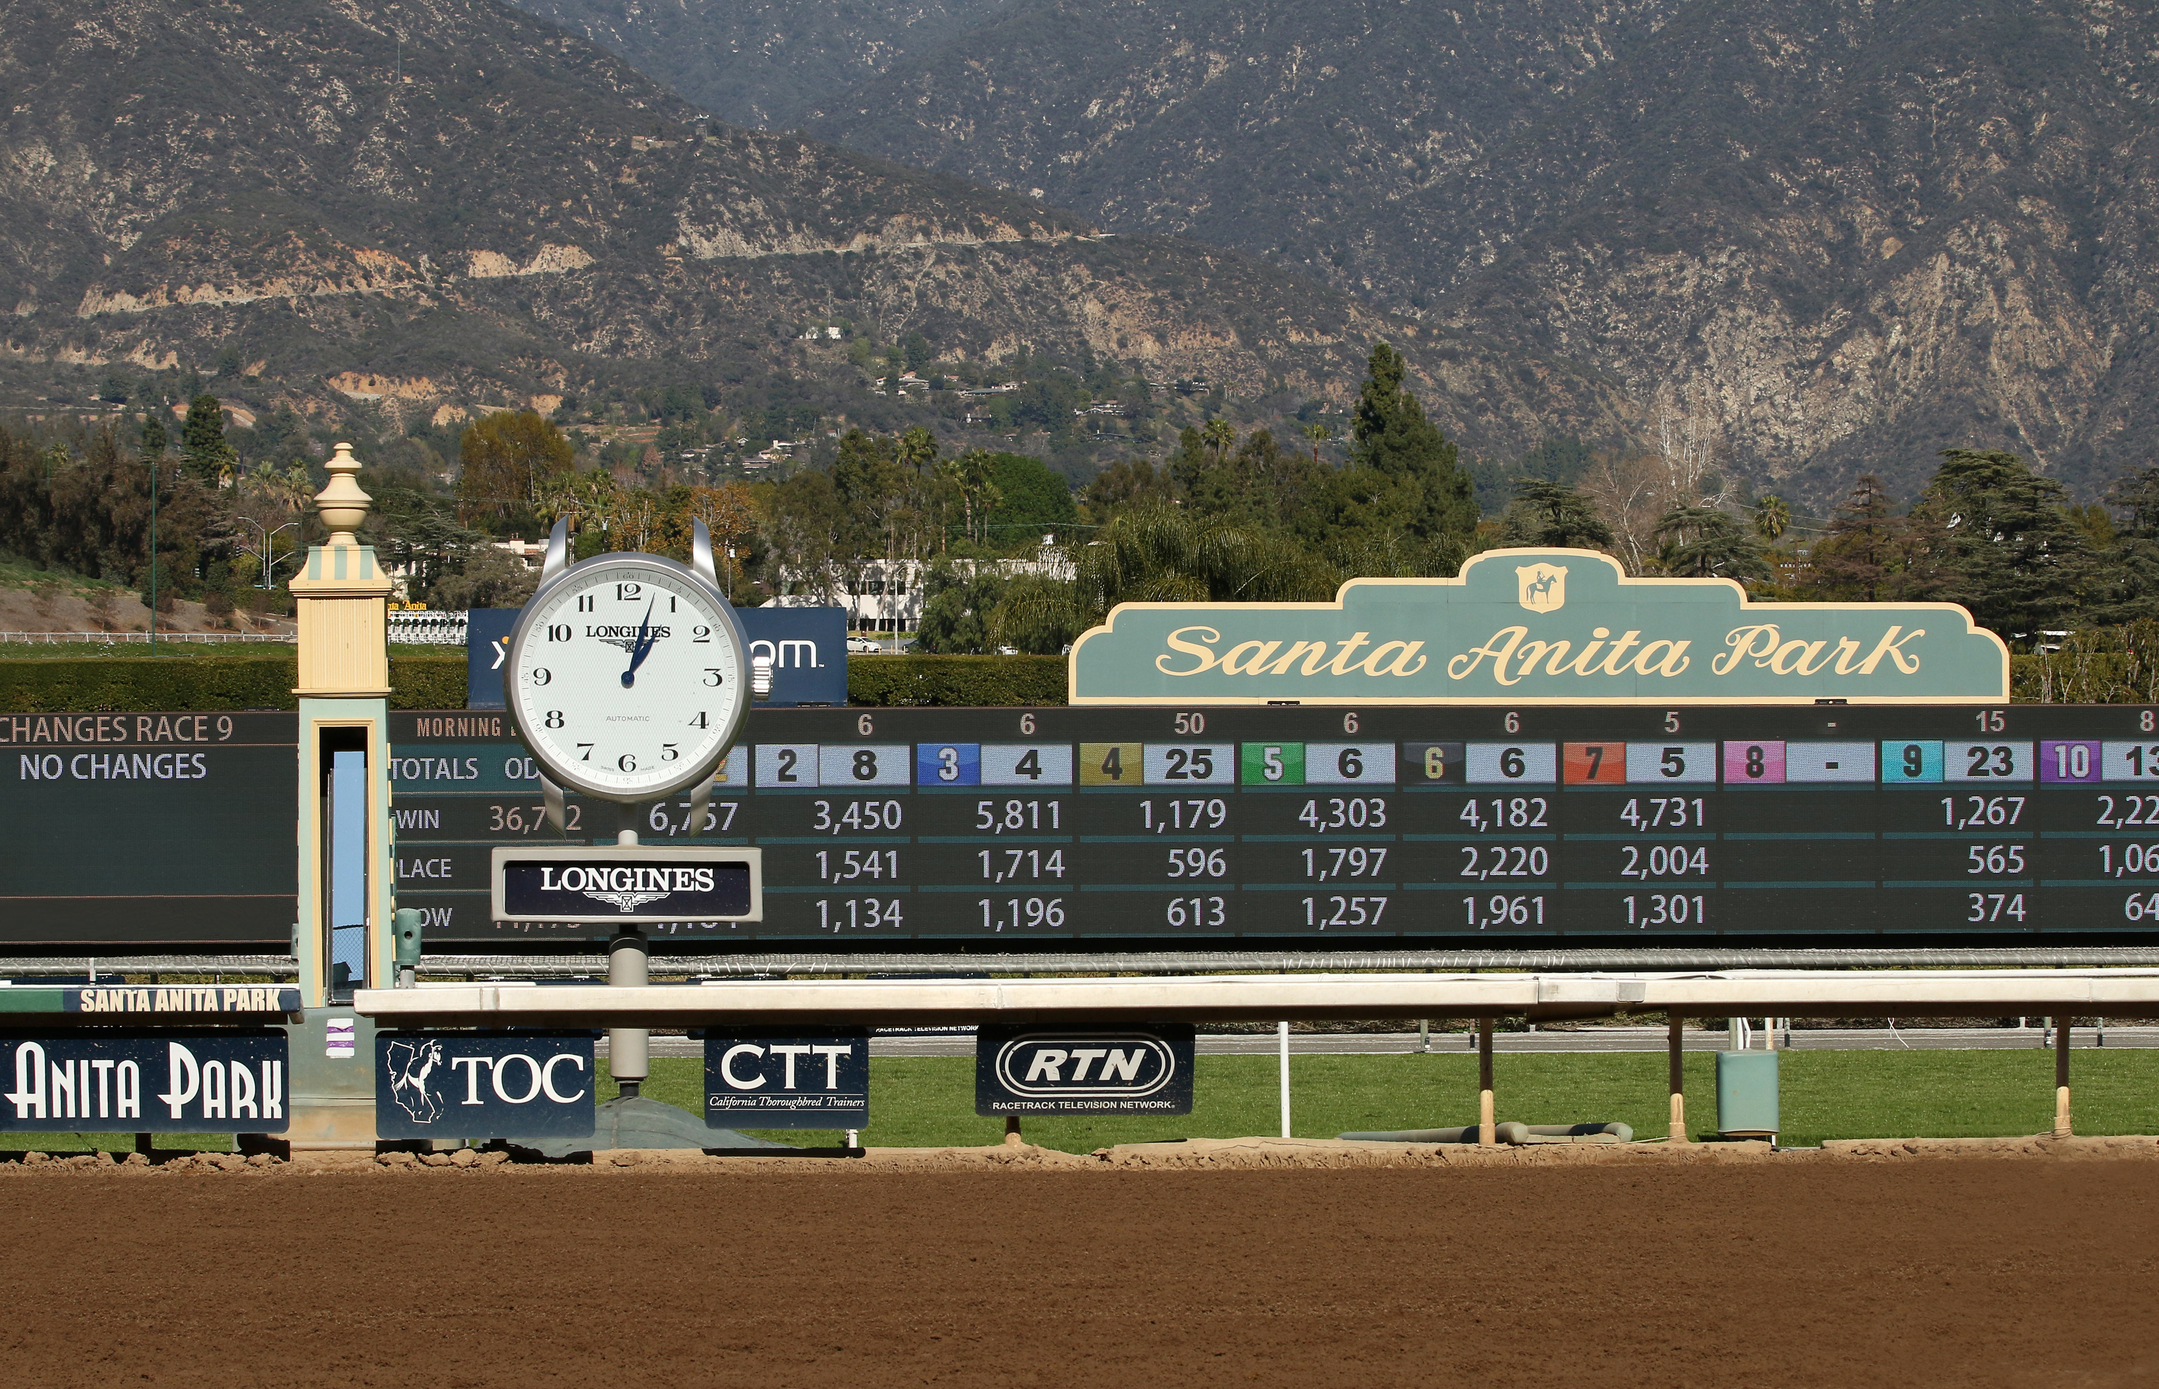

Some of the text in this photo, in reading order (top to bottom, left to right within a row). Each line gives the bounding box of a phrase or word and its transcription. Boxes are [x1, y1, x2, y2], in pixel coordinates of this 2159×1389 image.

[615, 582, 642, 601] 12
[577, 594, 594, 613] 11
[668, 595, 677, 613] 1
[547, 623, 572, 643] 10
[585, 625, 671, 638] LONGINES
[692, 624, 711, 643] 2
[1155, 623, 1926, 686] Santa Anita Park
[532, 667, 552, 686] 9
[702, 668, 723, 687] 3
[136, 715, 209, 741] RACE
[216, 715, 233, 741] 9
[416, 717, 501, 737] MORNING
[544, 709, 565, 729] 8
[687, 711, 710, 730] 4
[857, 713, 873, 736] 6
[1019, 712, 1036, 735] 6
[1174, 712, 1205, 734] 50
[1343, 712, 1359, 734] 6
[1504, 711, 1520, 734] 6
[1664, 711, 1680, 733] 5
[1975, 710, 2006, 732] 15
[2139, 710, 2156, 732] 8
[576, 742, 595, 761] 7
[661, 742, 679, 762] 5
[20, 753, 207, 780] NO CHANGES
[390, 757, 479, 780] TOTALS
[617, 753, 637, 773] 6
[777, 749, 798, 782] 2
[852, 749, 878, 781] 8
[936, 747, 960, 782] 3
[1014, 749, 1042, 780] 4
[1101, 747, 1123, 781] 4
[1165, 748, 1213, 780] 25
[1262, 746, 1285, 781] 5
[1338, 748, 1363, 779] 6
[1424, 746, 1445, 780] 6
[1499, 747, 1526, 778] 6
[1585, 746, 1604, 780] 7
[1659, 747, 1685, 778] 5
[1745, 745, 1765, 779] 8
[1902, 744, 1923, 778] 9
[1966, 746, 2015, 777] 23
[2053, 744, 2091, 779] 10
[395, 809, 440, 829] WIN
[489, 805, 582, 835] 36,72
[813, 800, 902, 835] 3,450
[975, 800, 1061, 834] 5,811
[1139, 799, 1227, 834] 1,179
[1299, 798, 1386, 833] 4,303
[1459, 798, 1548, 832] 4,182
[1620, 797, 1704, 832] 4,731
[1941, 796, 2026, 830] 1,267
[396, 858, 452, 878] LACE
[815, 850, 899, 884] 1,541
[977, 849, 1066, 883] 1,714
[1167, 848, 1227, 878] 596
[1302, 847, 1388, 882] 1,797
[1460, 846, 1548, 881] 2,220
[1620, 845, 1709, 880] 2,004
[1966, 845, 2025, 875] 565
[540, 867, 715, 892] LONGINES
[815, 898, 903, 933] 1,134
[978, 897, 1065, 932] 1,196
[1166, 896, 1226, 927] 613
[1302, 896, 1388, 931] 1,257
[1462, 895, 1545, 929] 1,961
[1623, 895, 1704, 929] 1,301
[1967, 893, 2027, 923] 374
[80, 988, 281, 1012] SANTA ANITA PARK
[720, 1043, 853, 1091] CTT
[1024, 1048, 1147, 1082] RTN
[3, 1041, 283, 1119] ANITA PARK
[450, 1053, 586, 1106] TOC
[709, 1096, 865, 1110] California Thoroughbred Trainers
[992, 1101, 1056, 1110] RACETRACK
[1058, 1100, 1118, 1110] TELEVISION
